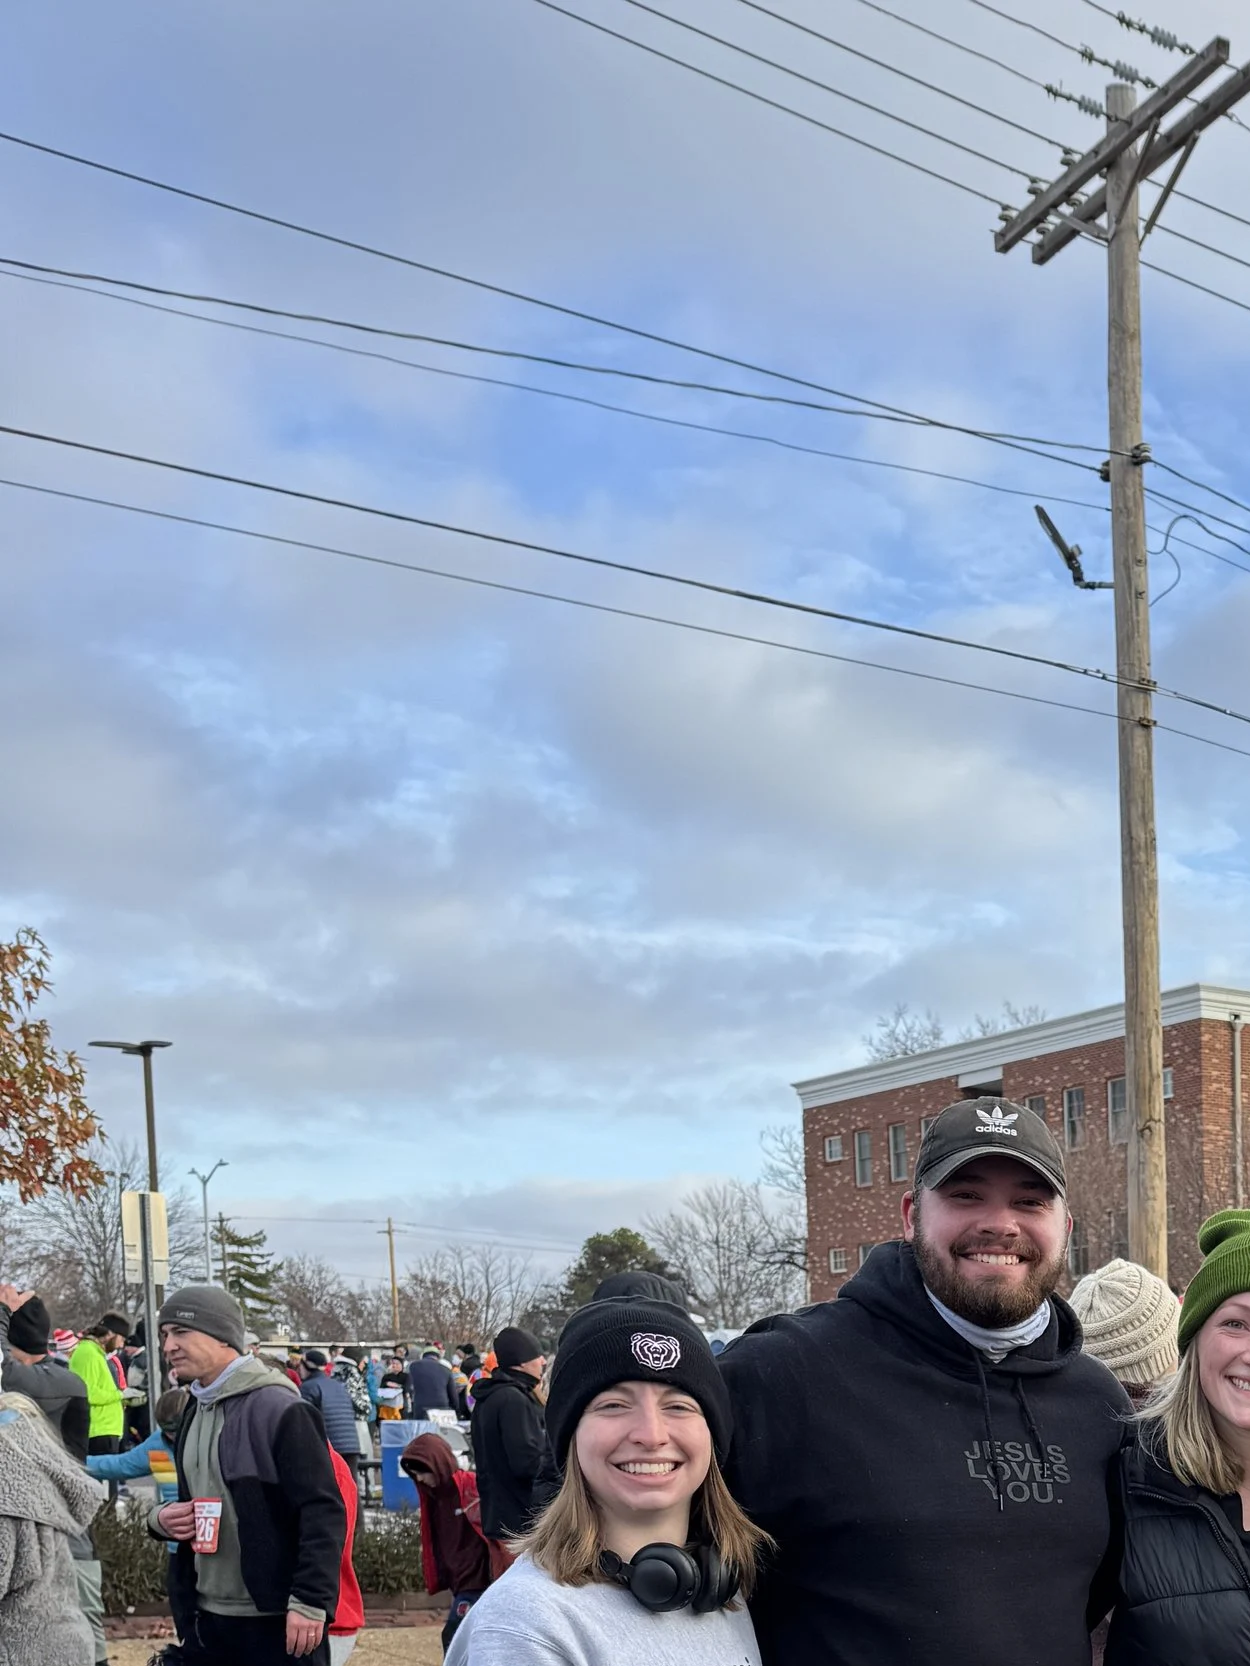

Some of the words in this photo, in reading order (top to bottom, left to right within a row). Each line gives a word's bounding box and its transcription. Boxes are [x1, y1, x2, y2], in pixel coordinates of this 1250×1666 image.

[975, 1124, 1018, 1137] adidas
[963, 1440, 1067, 1464] JESUS
[967, 1459, 1071, 1484] LOVES
[982, 1479, 1063, 1504] YOU.
[195, 1517, 215, 1542] 26
